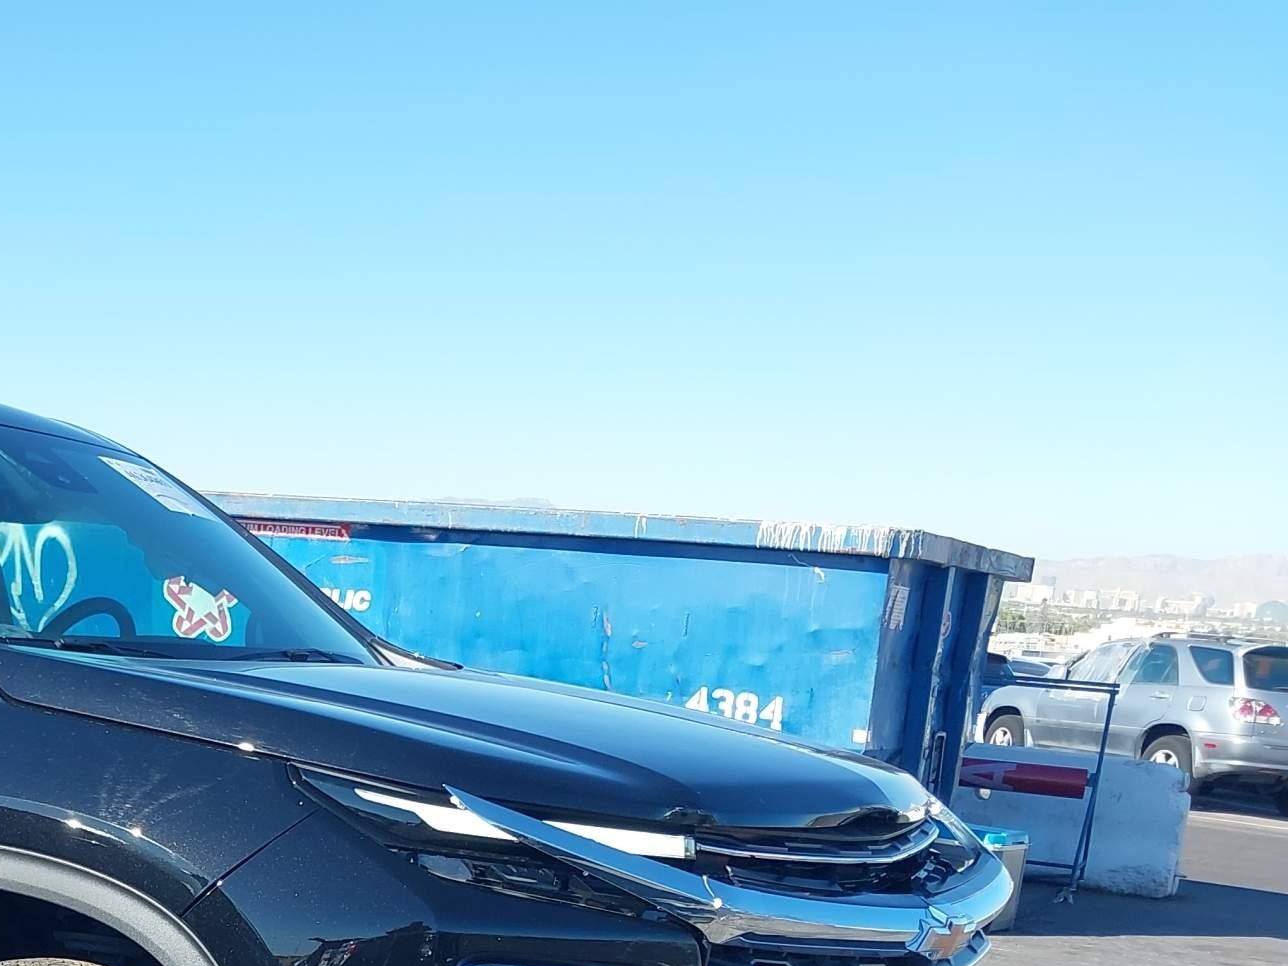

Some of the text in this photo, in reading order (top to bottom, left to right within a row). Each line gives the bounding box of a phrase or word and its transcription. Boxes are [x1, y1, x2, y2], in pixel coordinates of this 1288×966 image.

[262, 524, 307, 537] LOADING
[308, 526, 341, 538] LEVEL
[684, 686, 784, 732] 4384
